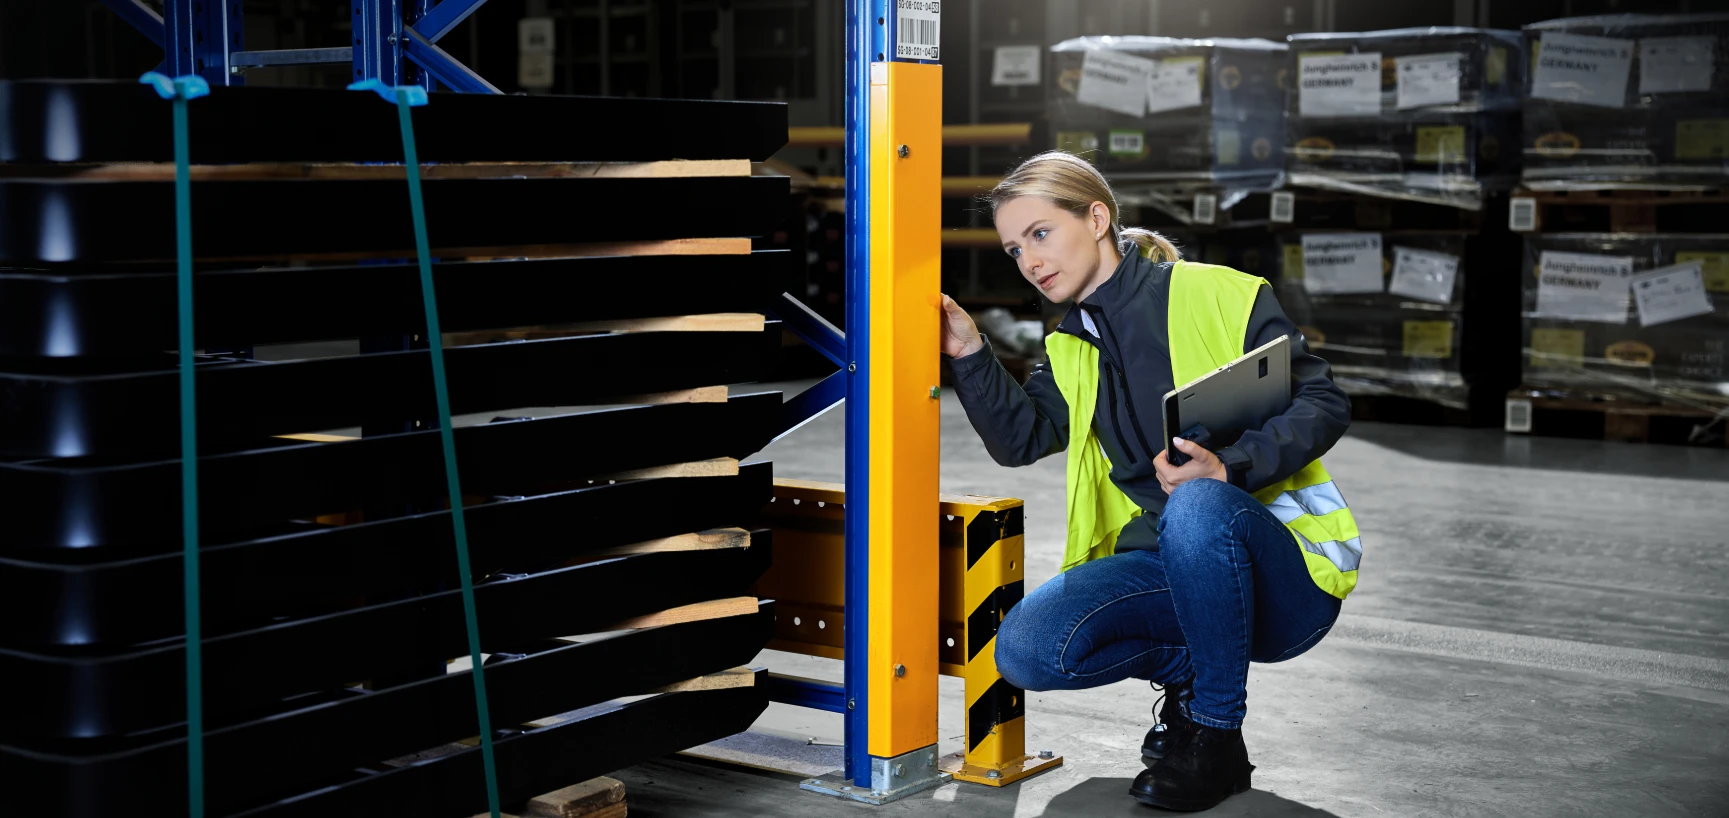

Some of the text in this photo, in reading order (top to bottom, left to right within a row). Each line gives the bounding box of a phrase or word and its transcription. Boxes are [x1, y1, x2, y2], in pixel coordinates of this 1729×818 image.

[1303, 61, 1368, 74] Jungheinrich
[1541, 57, 1599, 72] GERMANY
[1302, 77, 1355, 88] GERMANY
[1305, 254, 1356, 266] GERMANY
[1544, 258, 1617, 276] Jungheinrich
[1541, 273, 1601, 290] GERMANY
